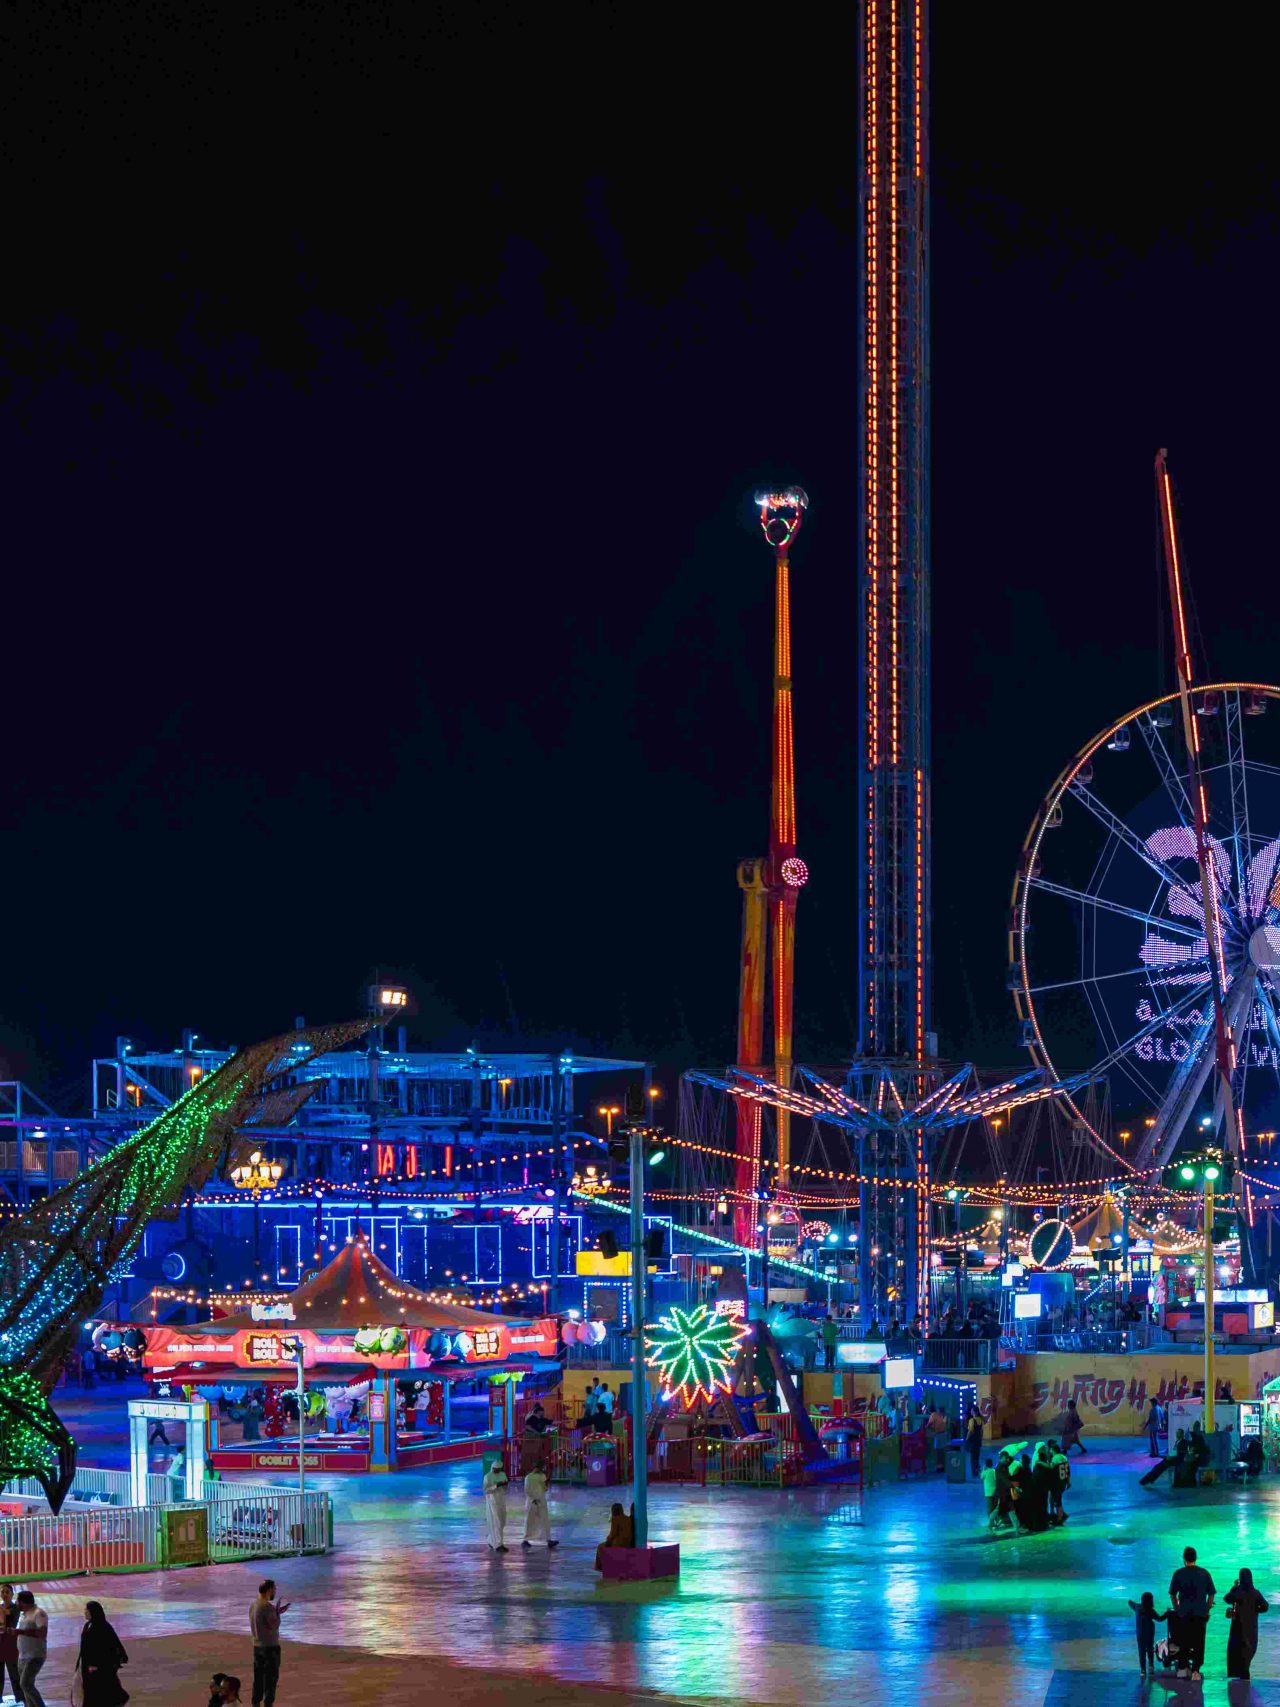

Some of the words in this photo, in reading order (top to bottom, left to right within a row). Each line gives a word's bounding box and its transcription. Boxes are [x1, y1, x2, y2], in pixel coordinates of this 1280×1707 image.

[252, 1337, 279, 1349] ROLL
[252, 1349, 279, 1360] ROLL
[258, 1455, 293, 1467] GOBLET
